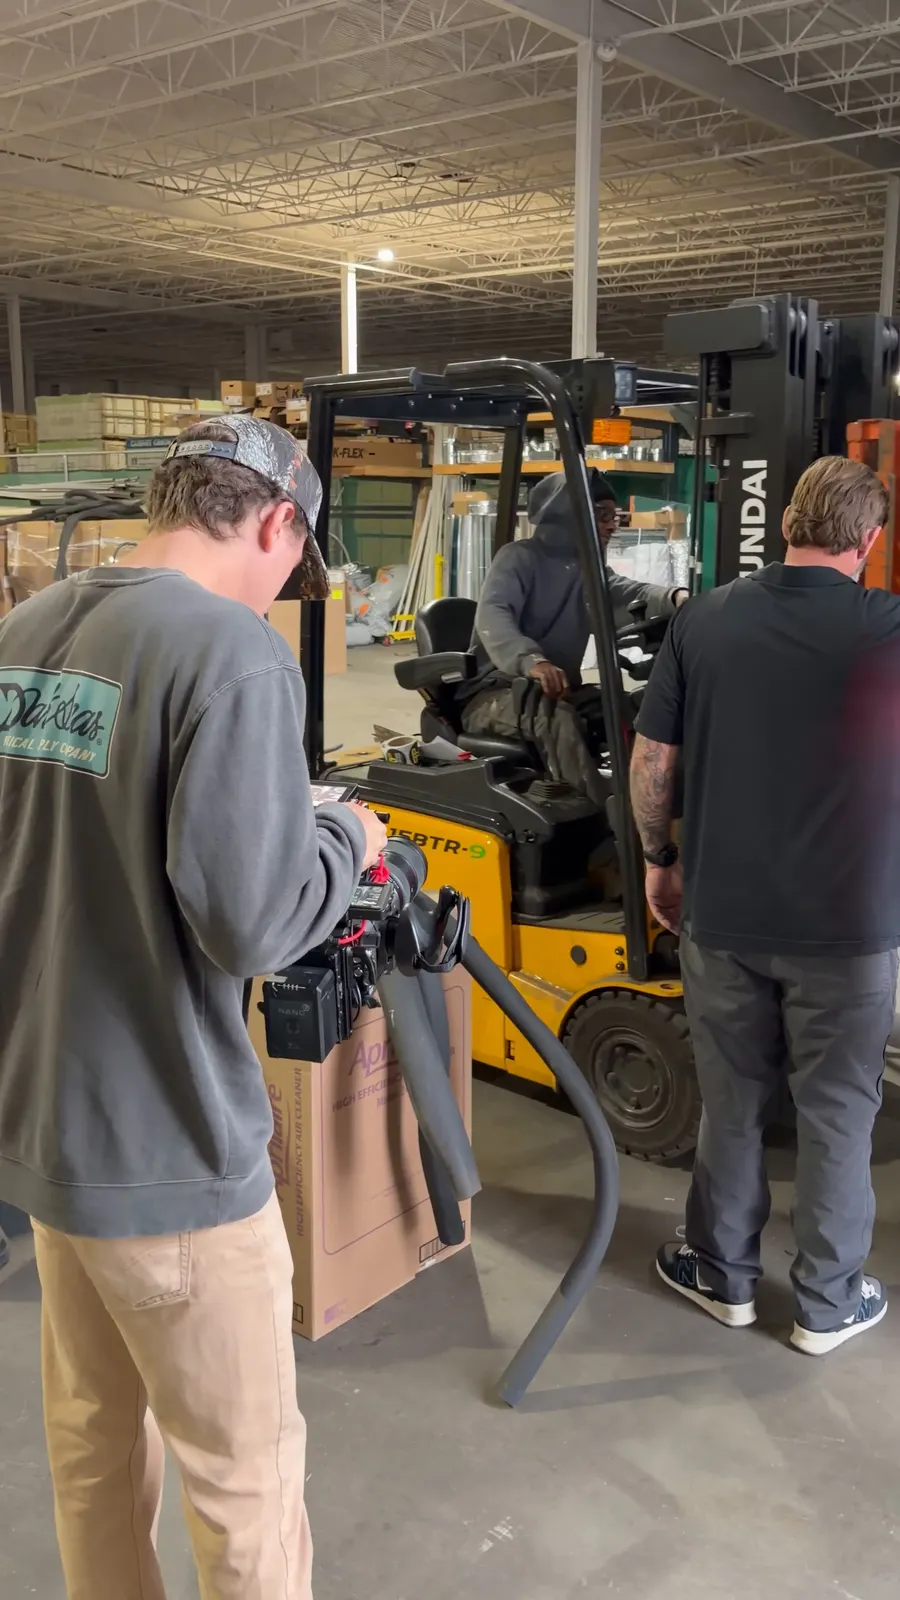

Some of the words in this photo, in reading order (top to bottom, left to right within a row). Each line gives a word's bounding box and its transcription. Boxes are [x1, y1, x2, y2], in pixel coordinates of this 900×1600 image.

[294, 1067, 302, 1120] CLEANER
[295, 1122, 303, 1141] AIR
[296, 1207, 304, 1237] HIGH
